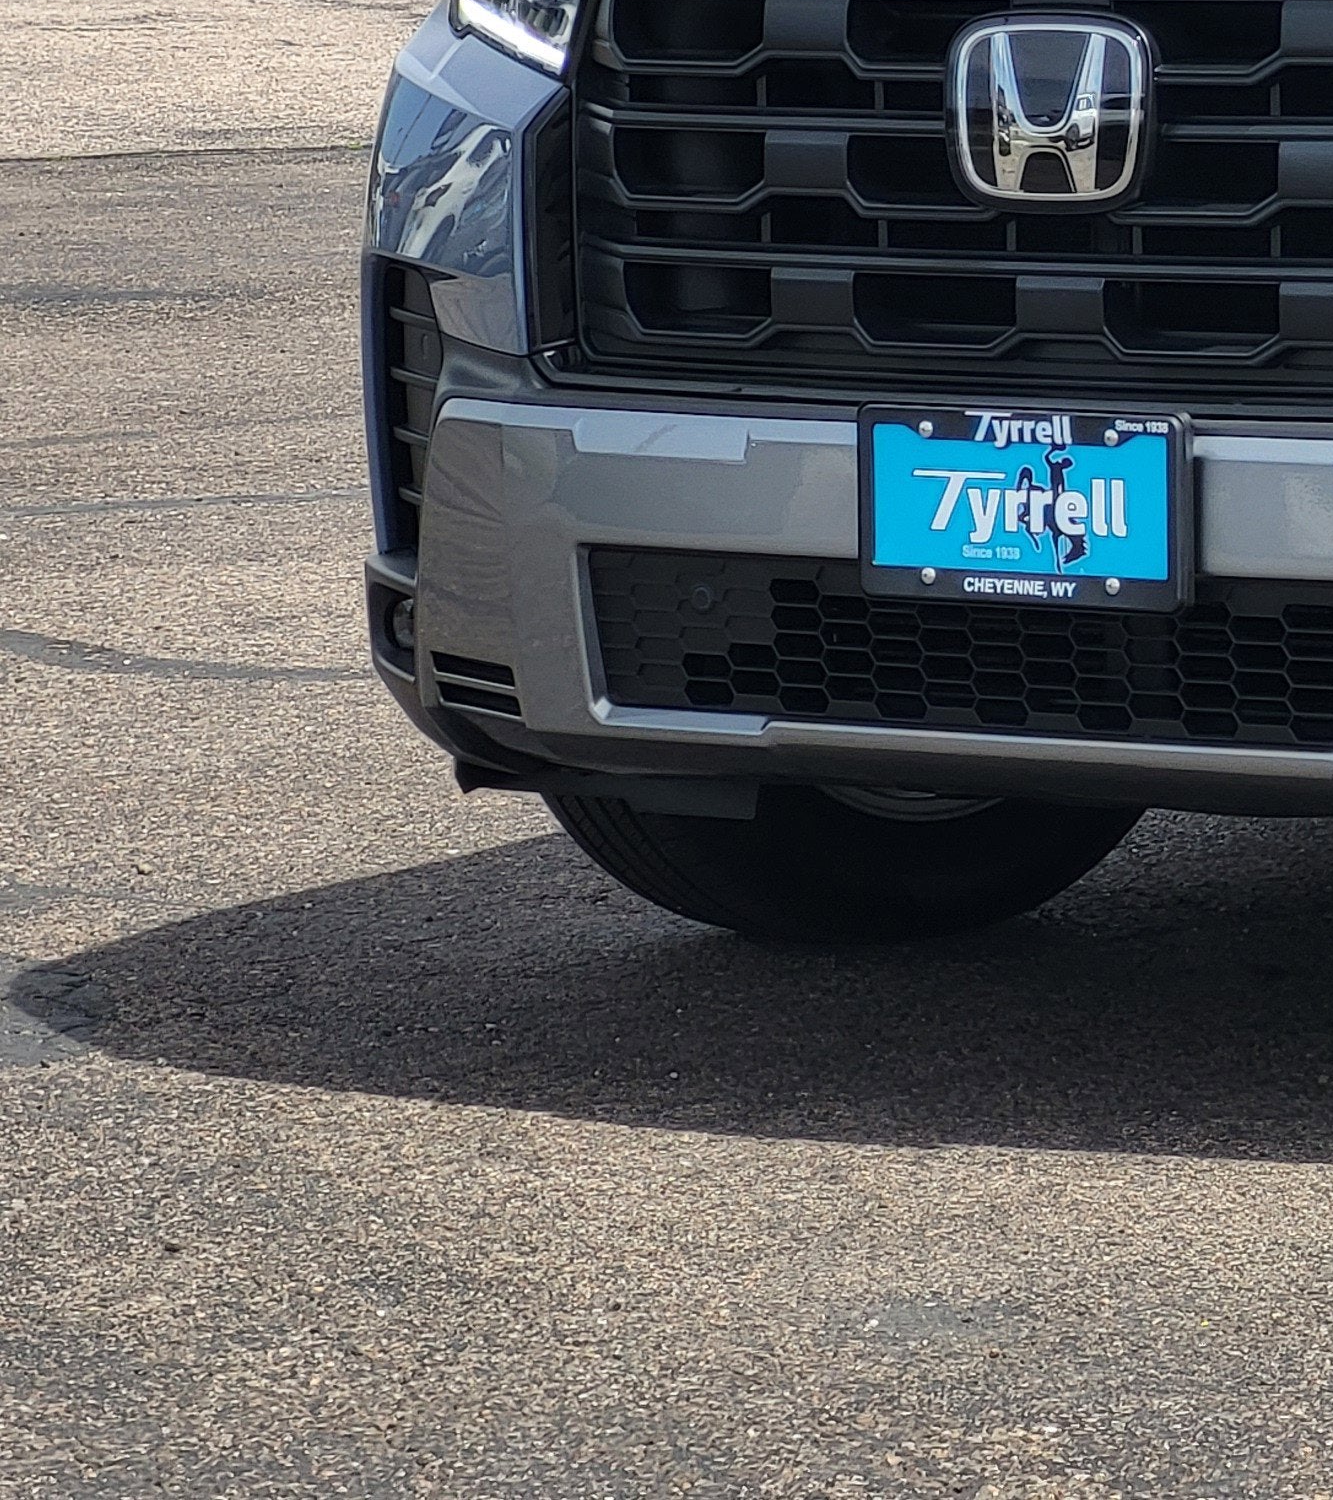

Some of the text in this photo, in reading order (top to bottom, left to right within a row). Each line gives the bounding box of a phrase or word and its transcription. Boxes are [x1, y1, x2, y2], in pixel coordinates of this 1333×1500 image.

[964, 410, 1073, 449] Tyrrell
[1114, 419, 1144, 432] Since
[912, 468, 1128, 544] Tyrrell
[962, 545, 993, 559] Since
[963, 577, 1077, 599] CHEYENNE, WY
